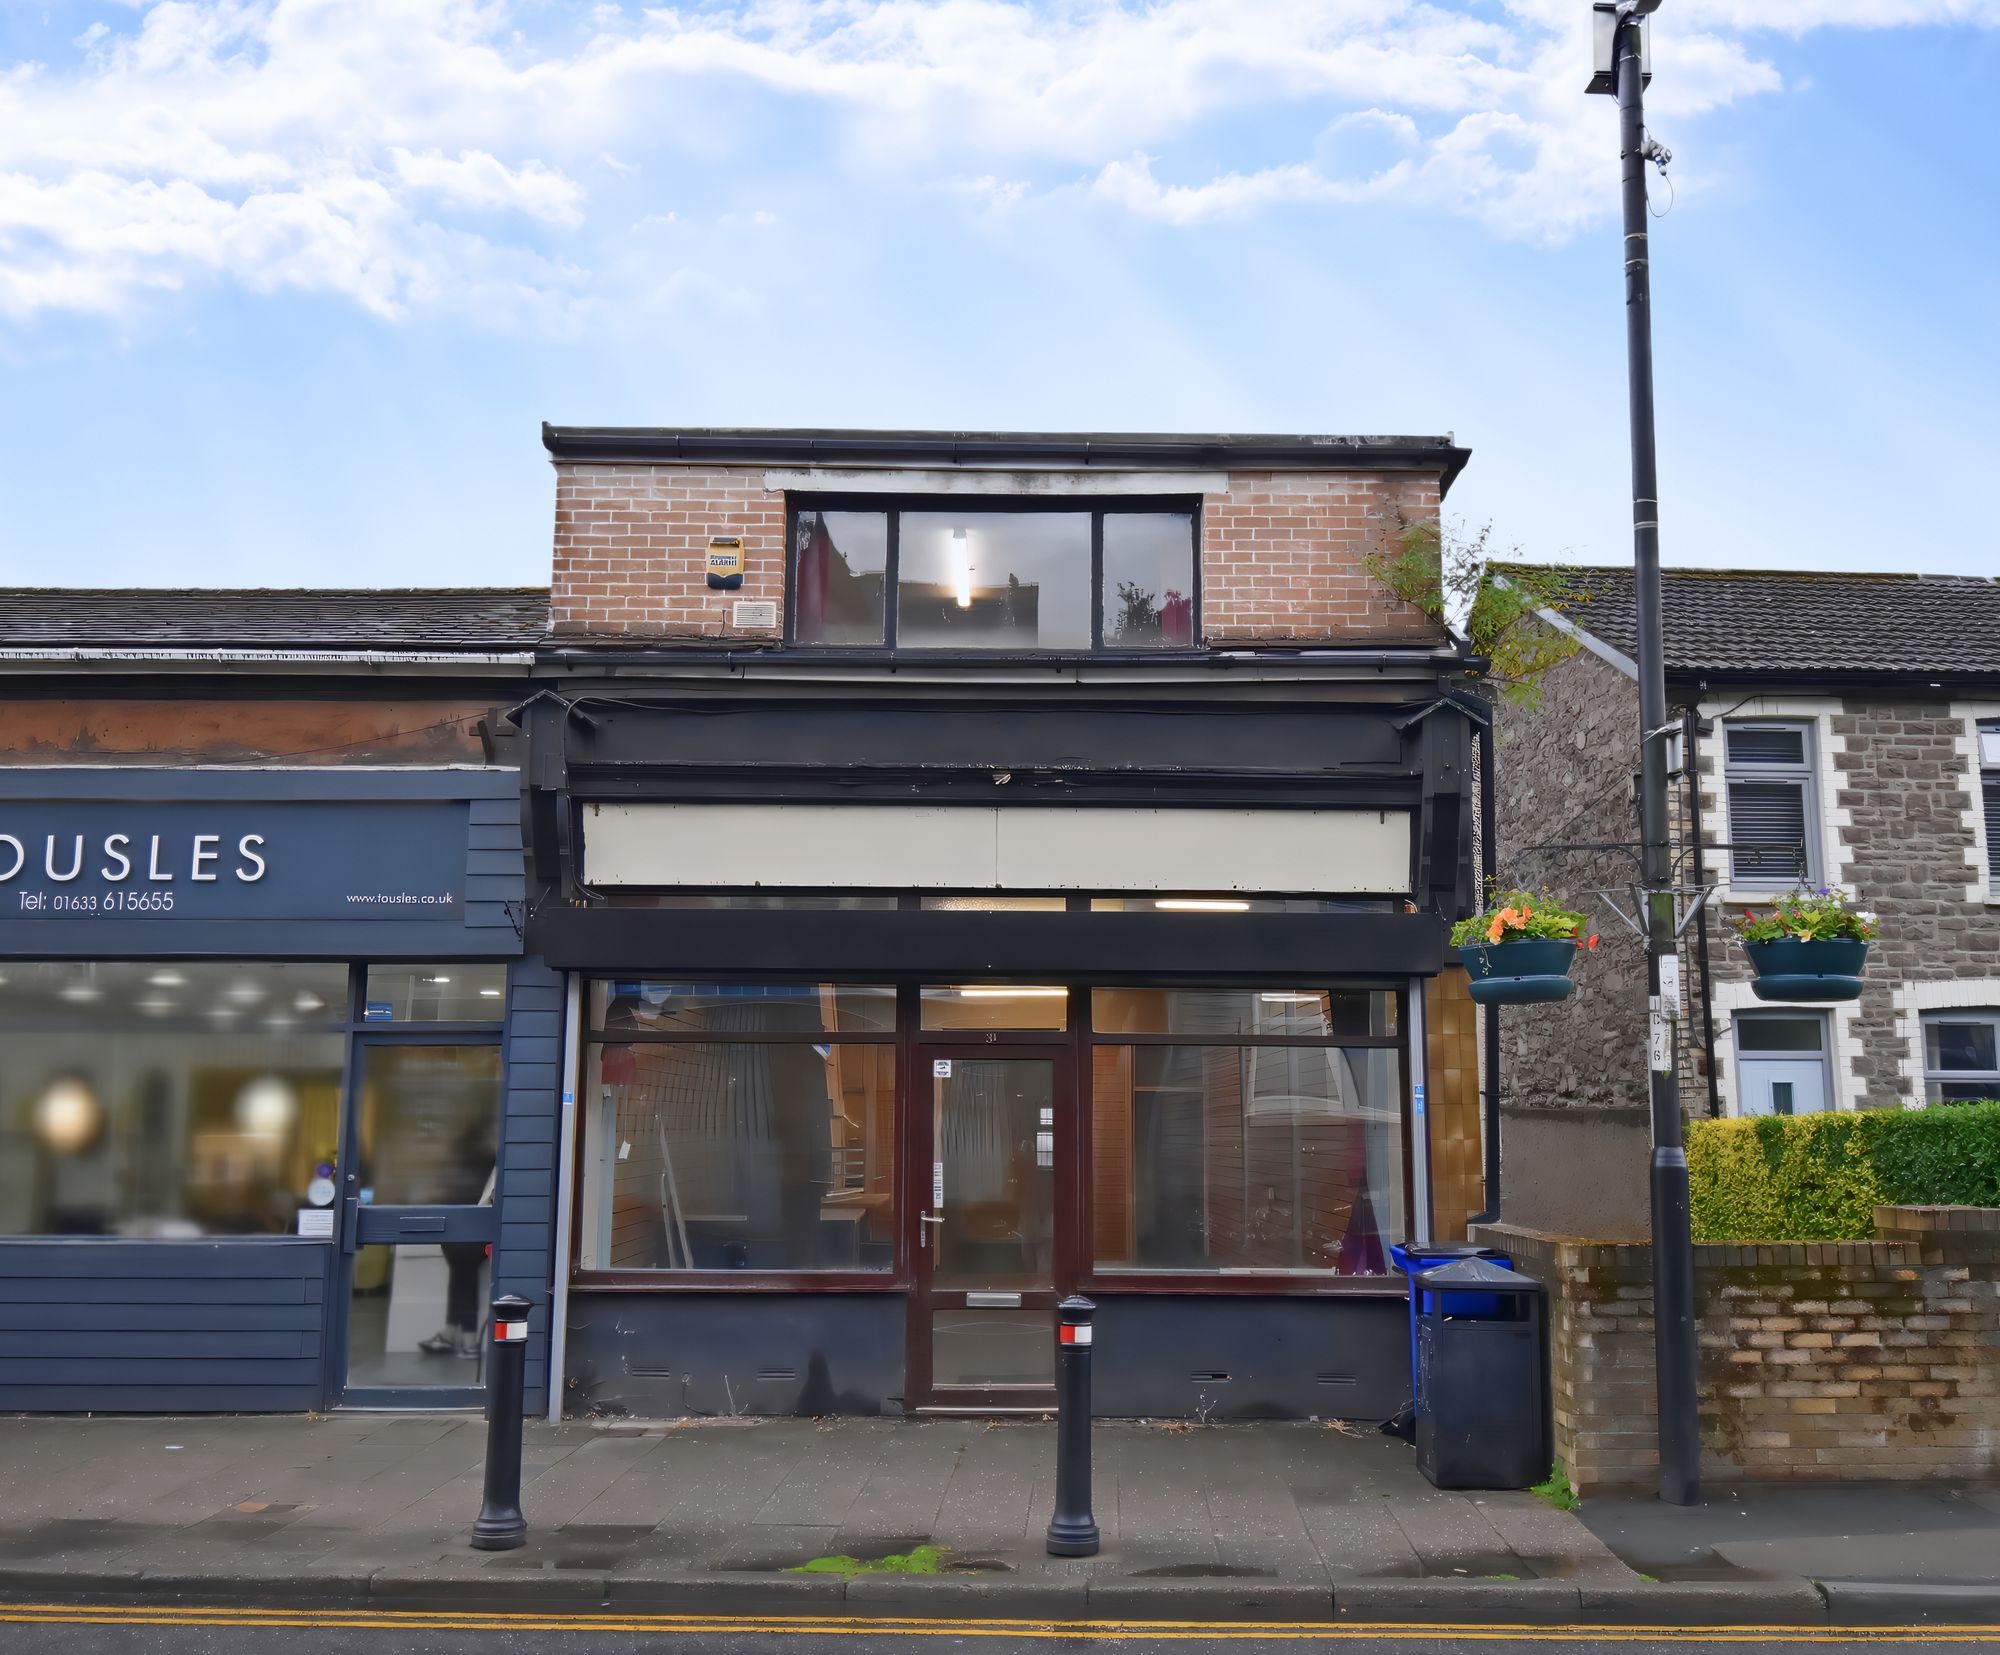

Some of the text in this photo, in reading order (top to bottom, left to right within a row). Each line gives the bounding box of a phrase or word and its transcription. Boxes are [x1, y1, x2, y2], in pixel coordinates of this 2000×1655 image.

[19, 891, 174, 911] Tel: 01633 615655
[346, 892, 453, 904] www.tousles.co.uk
[985, 1033, 997, 1044] 31
